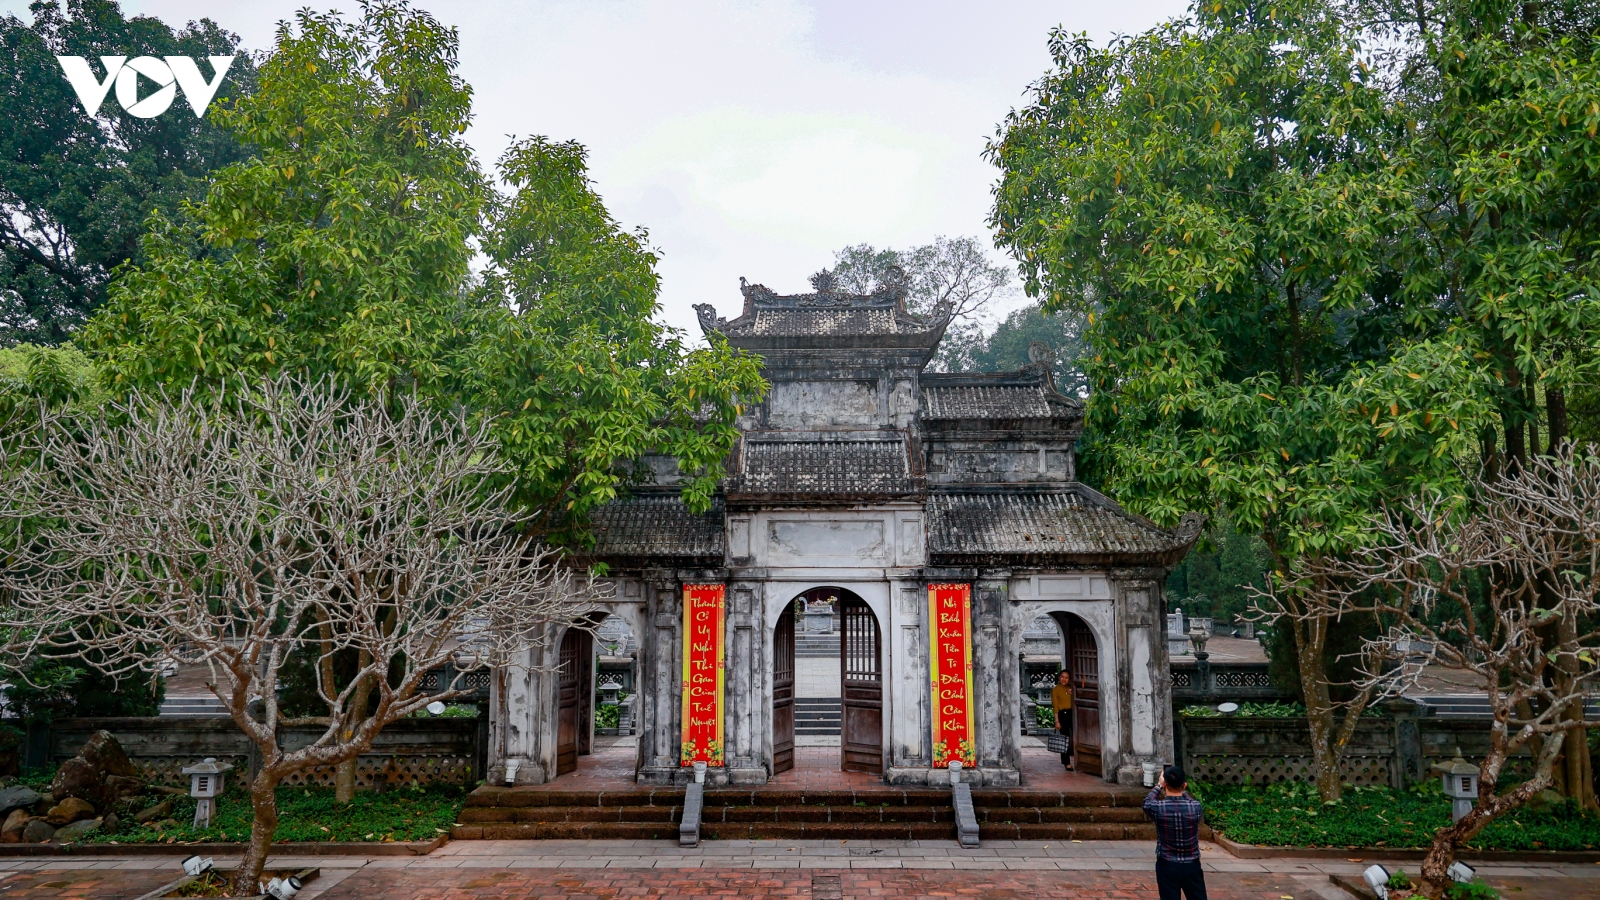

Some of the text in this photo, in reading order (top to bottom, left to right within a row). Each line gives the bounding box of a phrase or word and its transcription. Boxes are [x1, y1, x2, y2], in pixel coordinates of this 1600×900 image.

[940, 611, 960, 623] Bách
[698, 625, 710, 640] Uy
[939, 628, 962, 638] Xuân
[692, 640, 713, 659] Nghi
[692, 658, 713, 670] Thi
[946, 658, 957, 668] Tô
[692, 673, 713, 684] Gan
[940, 687, 965, 700] Cảnh
[692, 702, 713, 712] Tuế
[943, 704, 963, 715] Càn
[943, 718, 965, 731] Khôn
